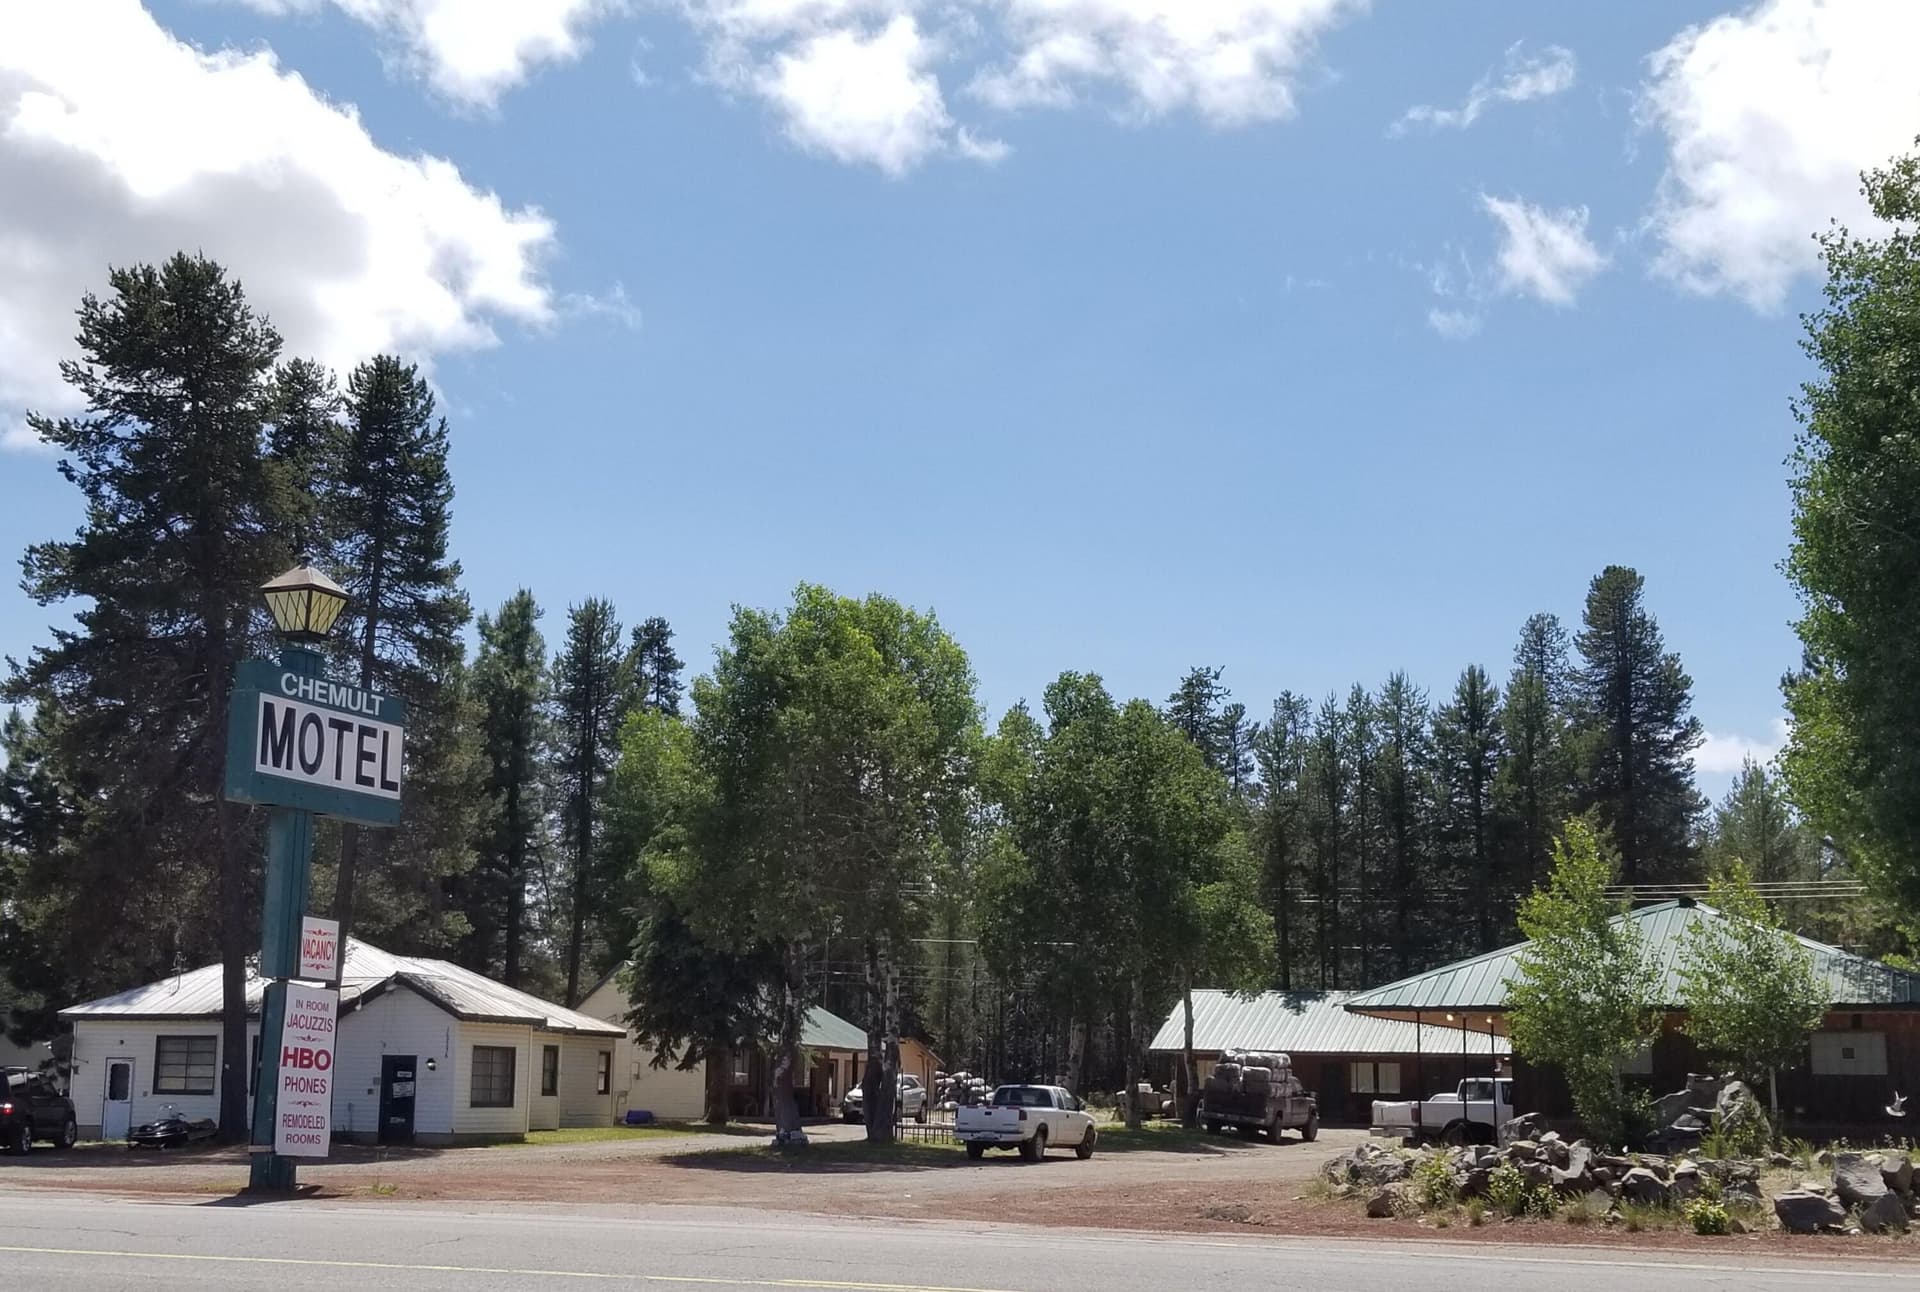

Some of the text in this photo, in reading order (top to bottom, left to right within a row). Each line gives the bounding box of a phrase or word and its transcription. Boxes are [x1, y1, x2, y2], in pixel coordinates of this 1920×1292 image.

[281, 673, 385, 716] CHEMULT
[260, 701, 399, 793] MOTEL
[302, 938, 337, 961] VACANCY
[295, 1000, 330, 1013] IN ROOM
[287, 1013, 334, 1033] JACUZZIS
[281, 1046, 332, 1071] HBO
[284, 1076, 327, 1095] PHONES
[282, 1114, 326, 1130] REMODELED
[286, 1133, 322, 1145] ROOMS
